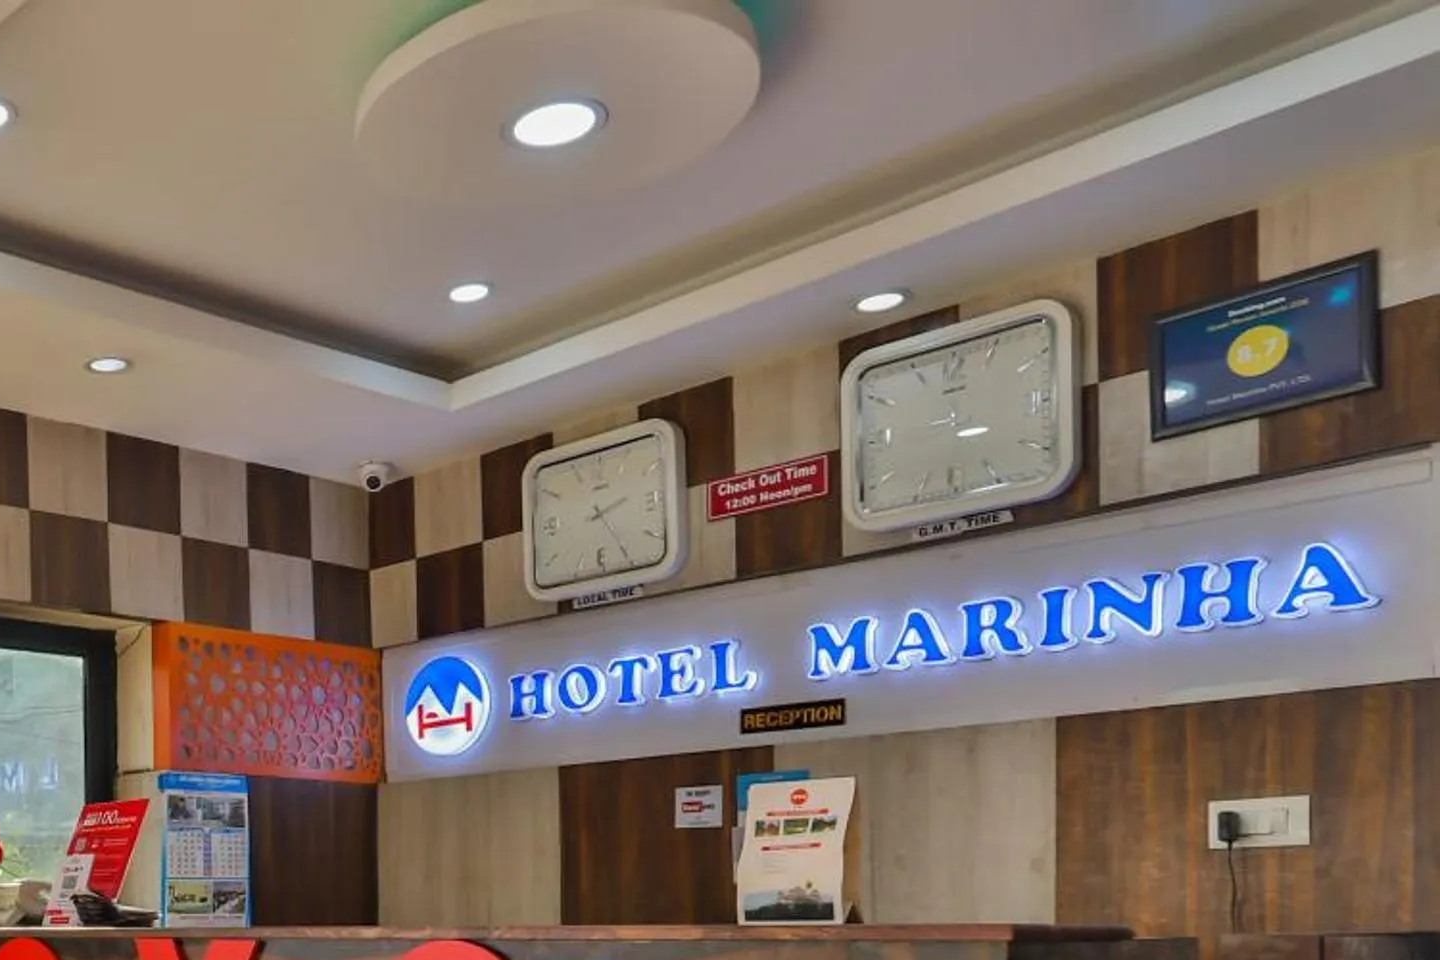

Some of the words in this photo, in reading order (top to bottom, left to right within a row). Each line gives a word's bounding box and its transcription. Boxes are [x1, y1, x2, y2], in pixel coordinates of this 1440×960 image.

[718, 478, 756, 497] Check
[760, 471, 782, 486] Out
[785, 464, 817, 481] Time
[724, 494, 758, 510] 12:00
[965, 513, 1000, 528] TIME
[576, 590, 609, 606] LOCAL
[509, 640, 757, 720] HOTEL
[807, 542, 1382, 681] MARINHA
[743, 704, 843, 731] RECEPTION
